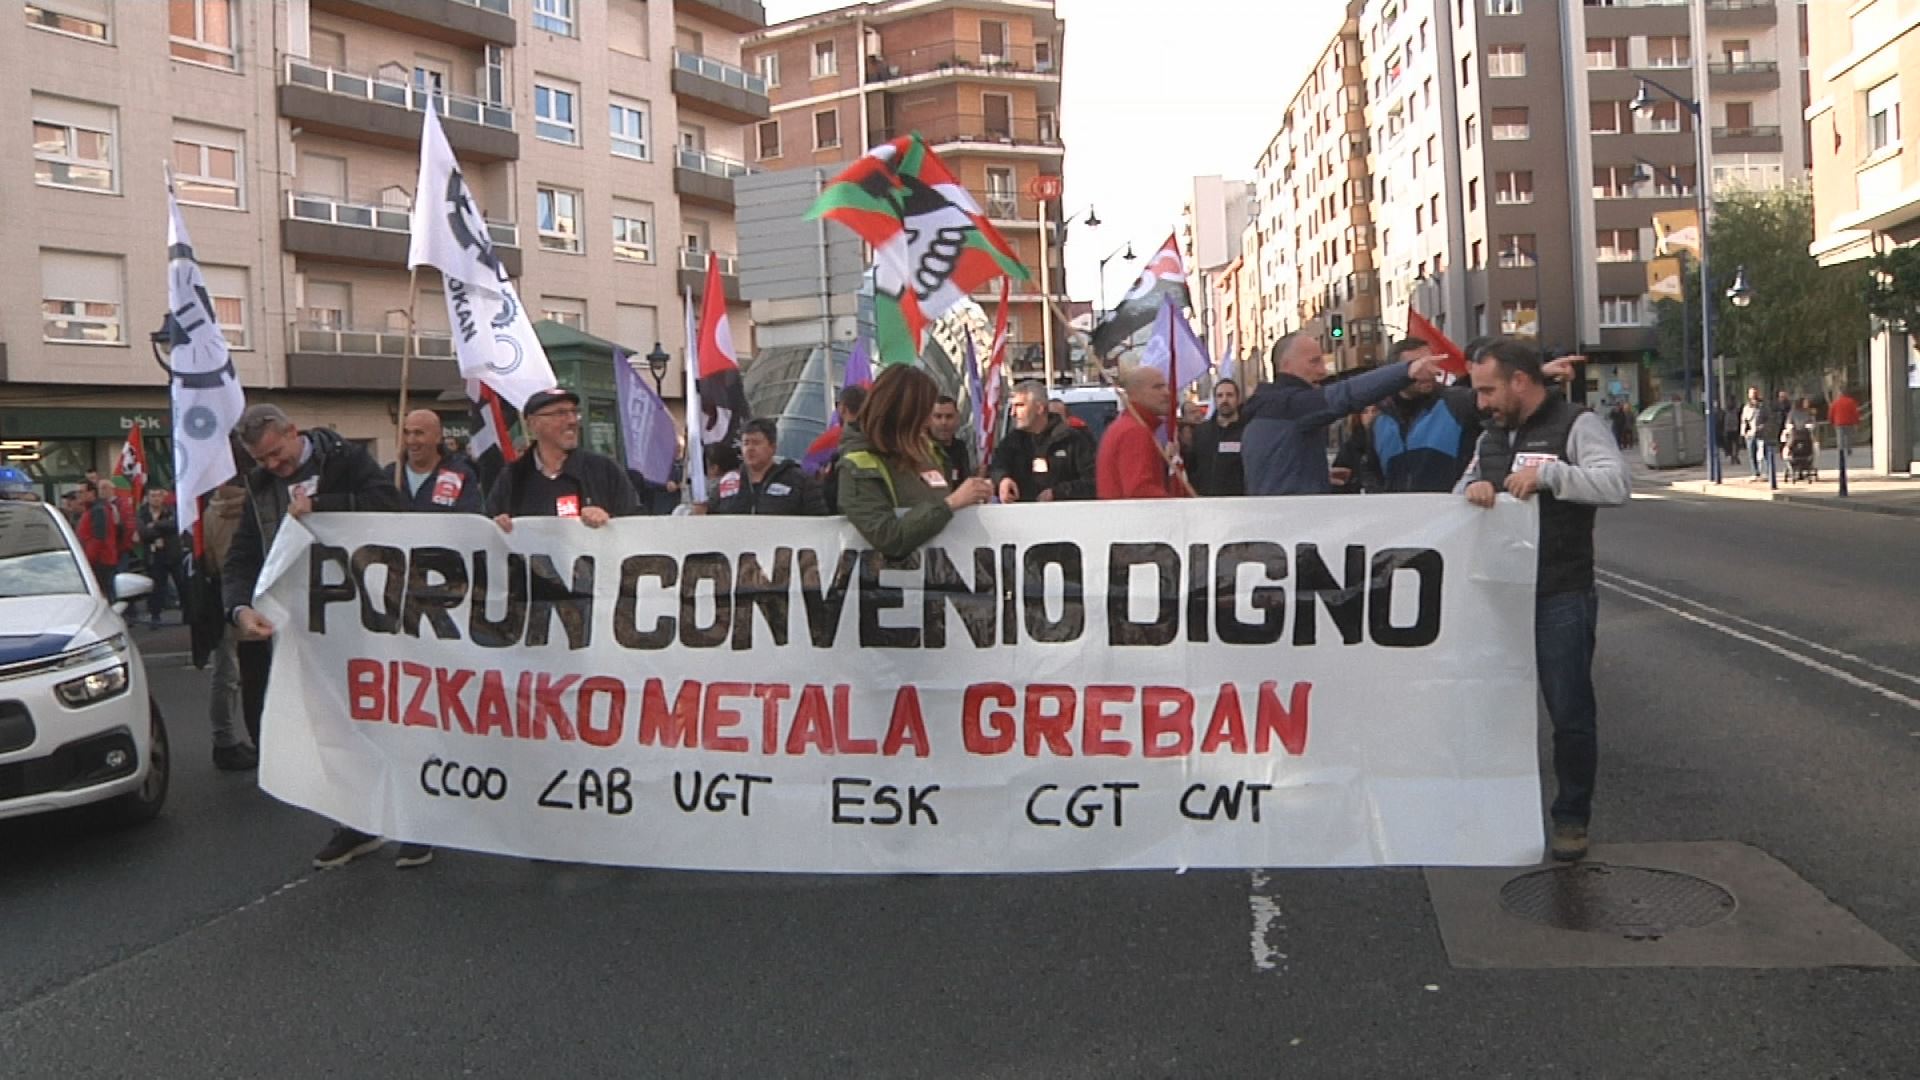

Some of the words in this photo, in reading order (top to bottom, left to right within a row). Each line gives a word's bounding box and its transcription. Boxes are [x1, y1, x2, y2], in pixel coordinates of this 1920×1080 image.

[445, 273, 478, 343] OKAN
[613, 541, 1085, 651] CONVENIO
[1107, 541, 1445, 648] DIGNO
[346, 658, 625, 748] BIZKAIKO
[638, 678, 930, 758] METALA
[962, 679, 1312, 759] GREBAN
[420, 757, 508, 801] CCOO
[537, 768, 633, 815] LAB
[673, 771, 773, 817] UGT
[832, 778, 941, 826] ESK
[1025, 782, 1139, 827] CGT
[1179, 780, 1273, 823] CNT
